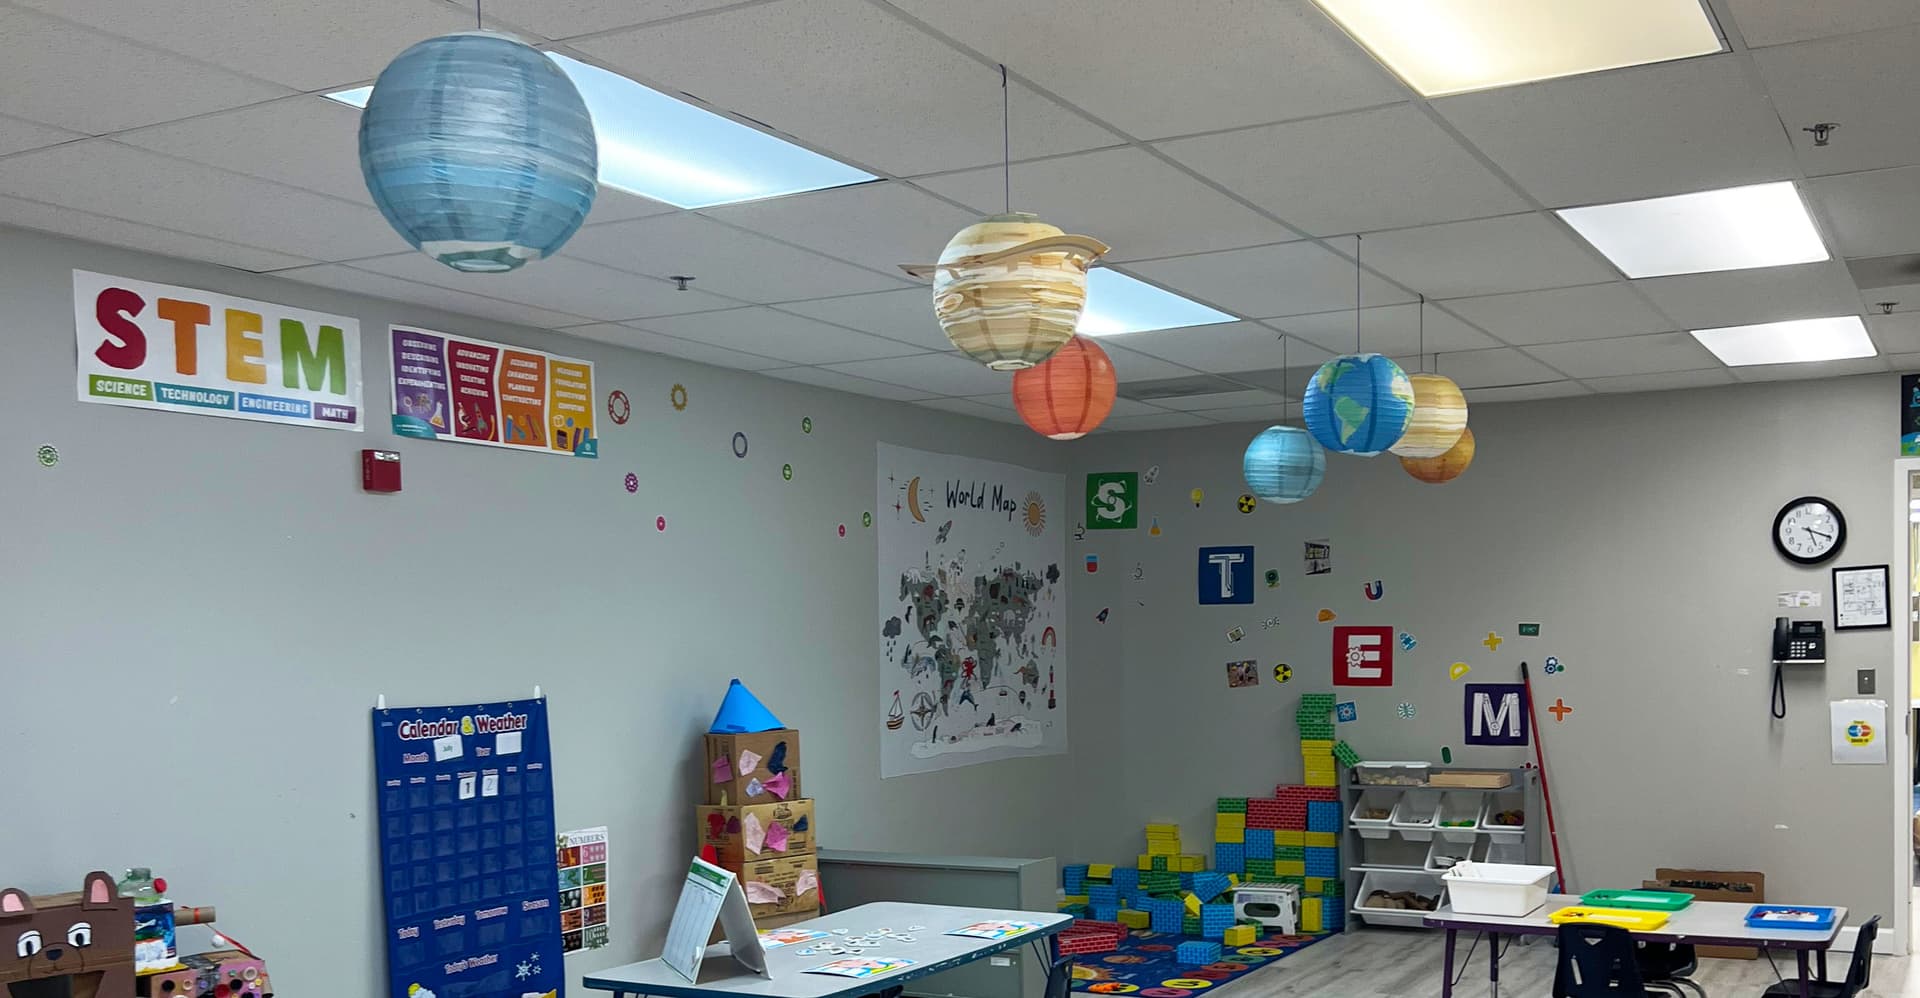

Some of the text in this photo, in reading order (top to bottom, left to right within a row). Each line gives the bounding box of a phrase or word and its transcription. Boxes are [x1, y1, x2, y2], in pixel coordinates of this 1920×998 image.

[94, 287, 346, 395] STEM
[95, 379, 349, 420] SCIENCE TECHNOLOGY ENGINEERING MATH
[946, 479, 1017, 522] World Map
[1094, 480, 1129, 522] S
[1825, 514, 1831, 524] 2
[1828, 524, 1834, 533] 3
[1788, 536, 1795, 545] 8
[1796, 542, 1802, 551] 7
[1817, 541, 1824, 551] 5
[1807, 545, 1814, 554] 6
[1208, 553, 1246, 599] T
[1346, 634, 1382, 678] E
[1471, 692, 1521, 737] M
[398, 712, 528, 740] Calendar & Weather
[402, 752, 430, 764] Month
[475, 747, 491, 757] Year
[486, 777, 494, 791] 2
[569, 834, 606, 845] NUMBERS
[522, 898, 550, 911] Season
[433, 915, 466, 930] Yesterday
[397, 926, 419, 940] Today
[467, 953, 499, 968] Weather
